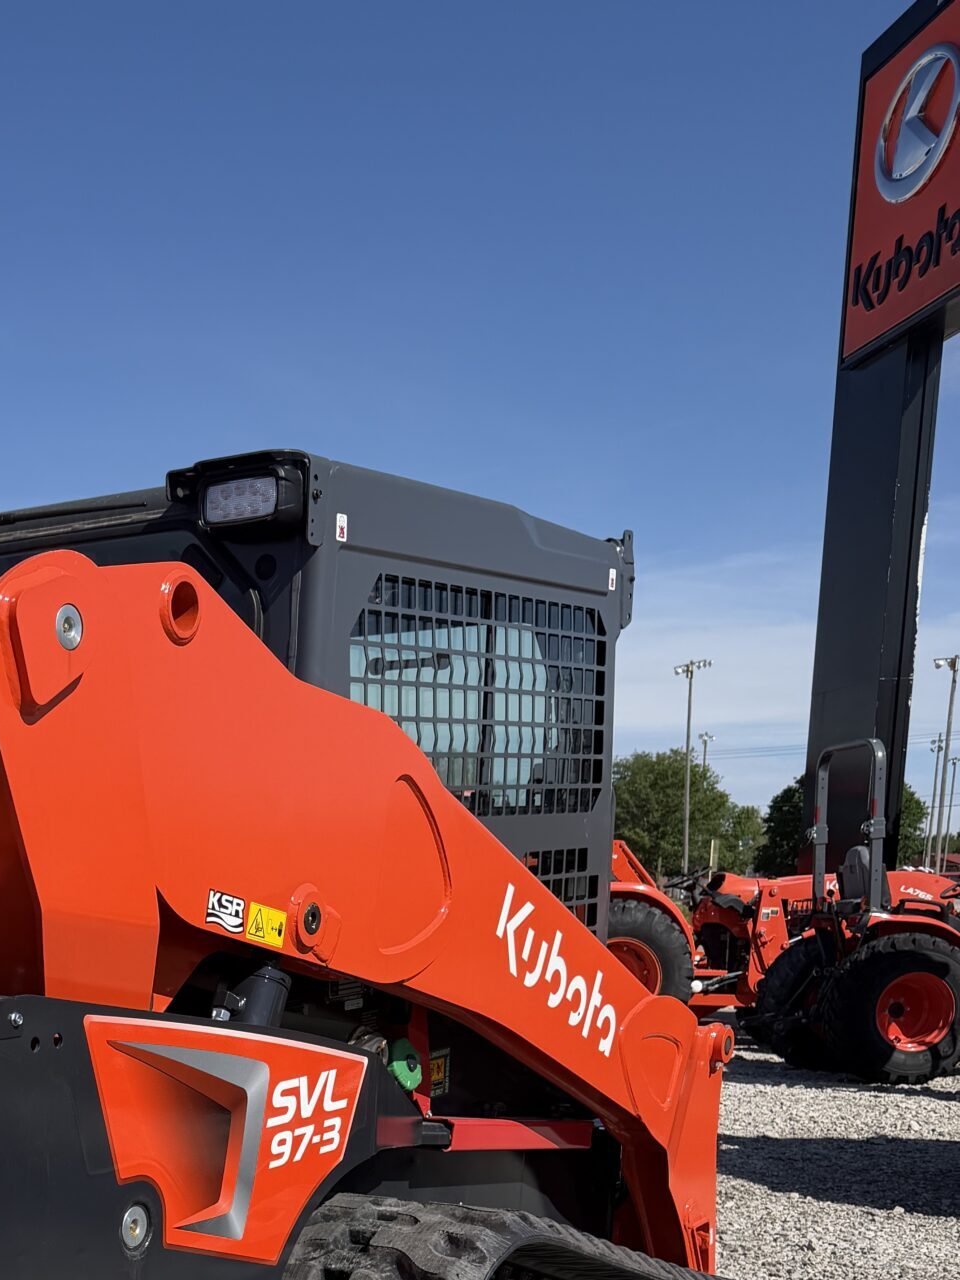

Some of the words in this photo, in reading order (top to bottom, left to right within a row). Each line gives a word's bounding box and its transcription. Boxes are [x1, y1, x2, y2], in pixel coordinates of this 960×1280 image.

[208, 890, 245, 918] KSR
[496, 882, 617, 1058] Kubota
[266, 1069, 348, 1128] SVL
[268, 1117, 342, 1169] 97-3
